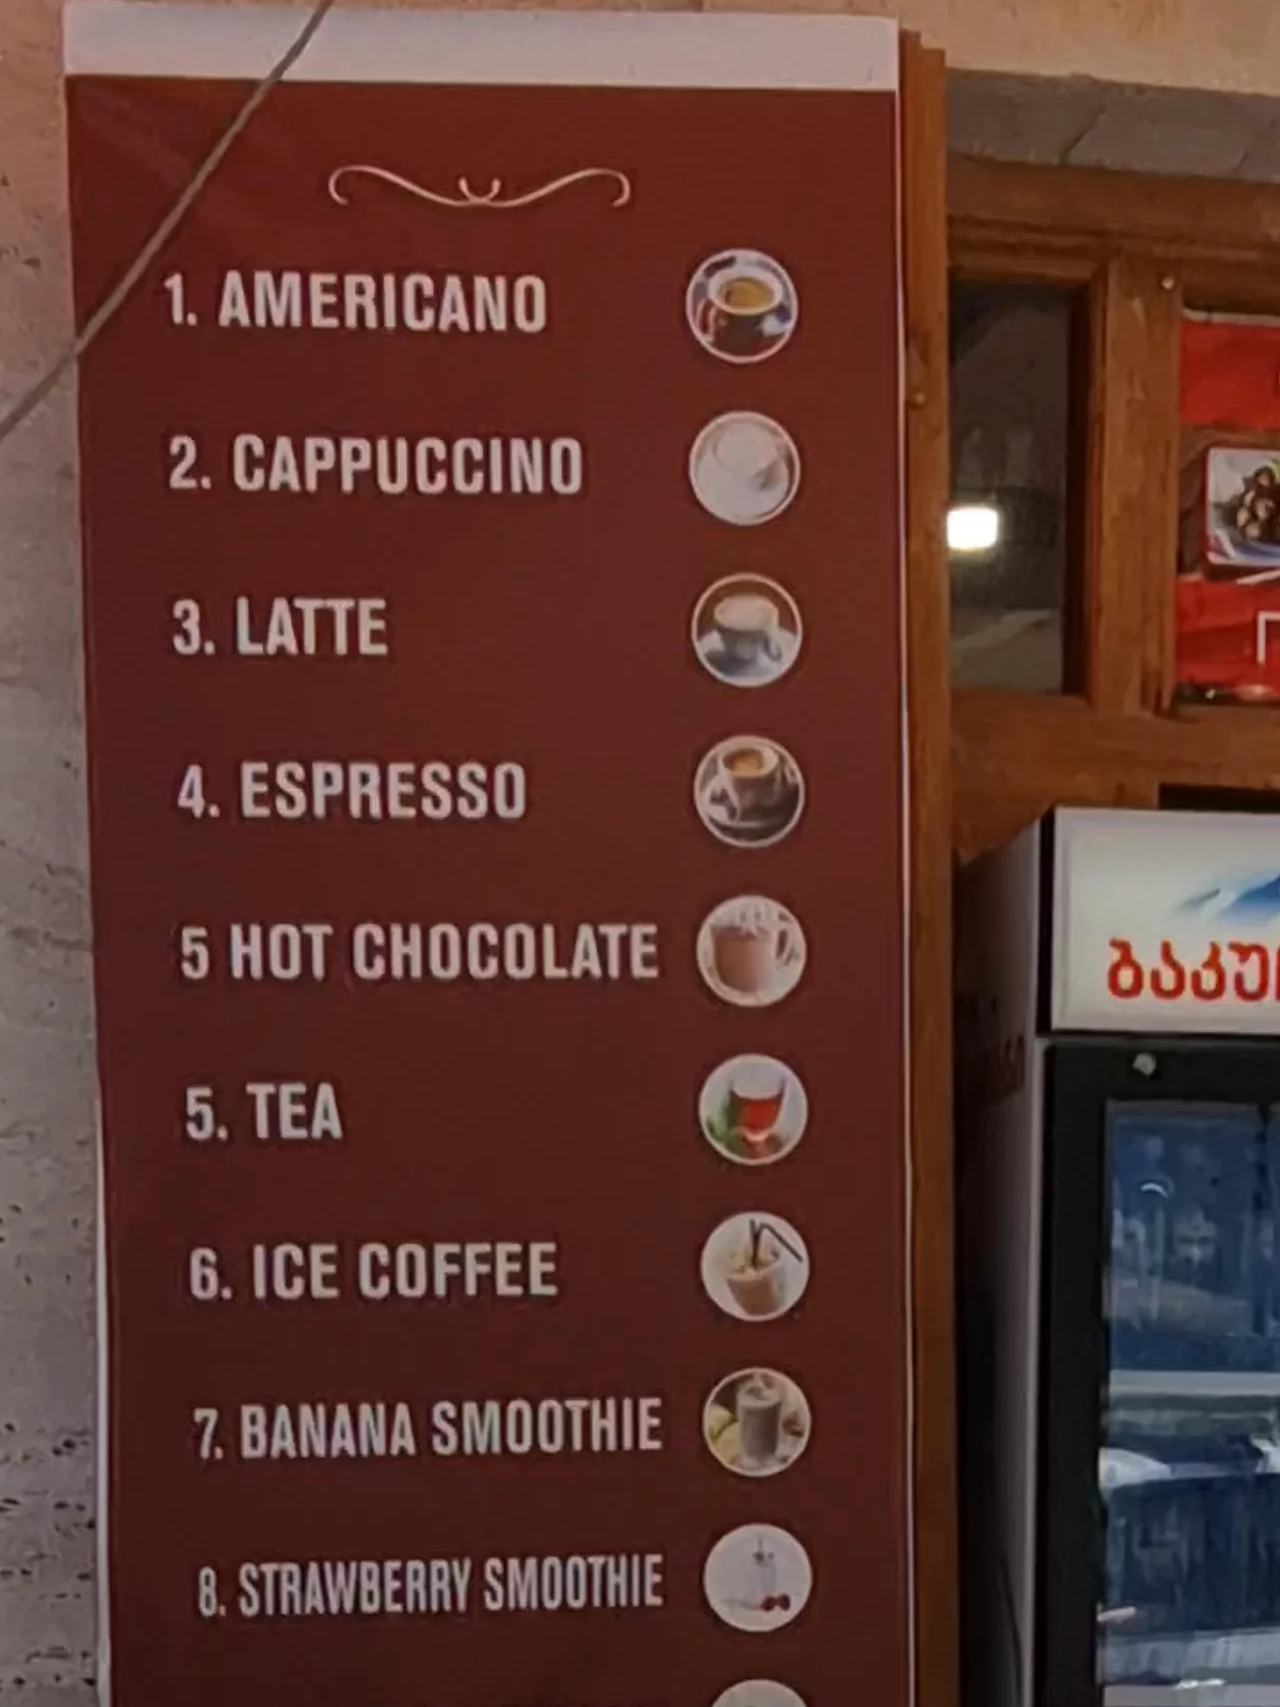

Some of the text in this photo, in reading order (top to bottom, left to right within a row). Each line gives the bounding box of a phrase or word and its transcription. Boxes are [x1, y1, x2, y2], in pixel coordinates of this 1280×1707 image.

[163, 269, 547, 334] 1. AMERICANO
[168, 433, 583, 496] 2. CAPPUCCINO
[172, 595, 389, 656] 3. LATTE
[176, 761, 526, 820] 4. ESPRESSO
[180, 922, 659, 981] 5 HOT CHOCOLATE
[185, 1081, 343, 1141] 5. TEA
[189, 1241, 559, 1300] 6. ICE COFFEE
[193, 1396, 663, 1460] 7. BANANA SMOOTHIE
[197, 1553, 664, 1618] 8. STRAWBERRY SMOOTHIE
